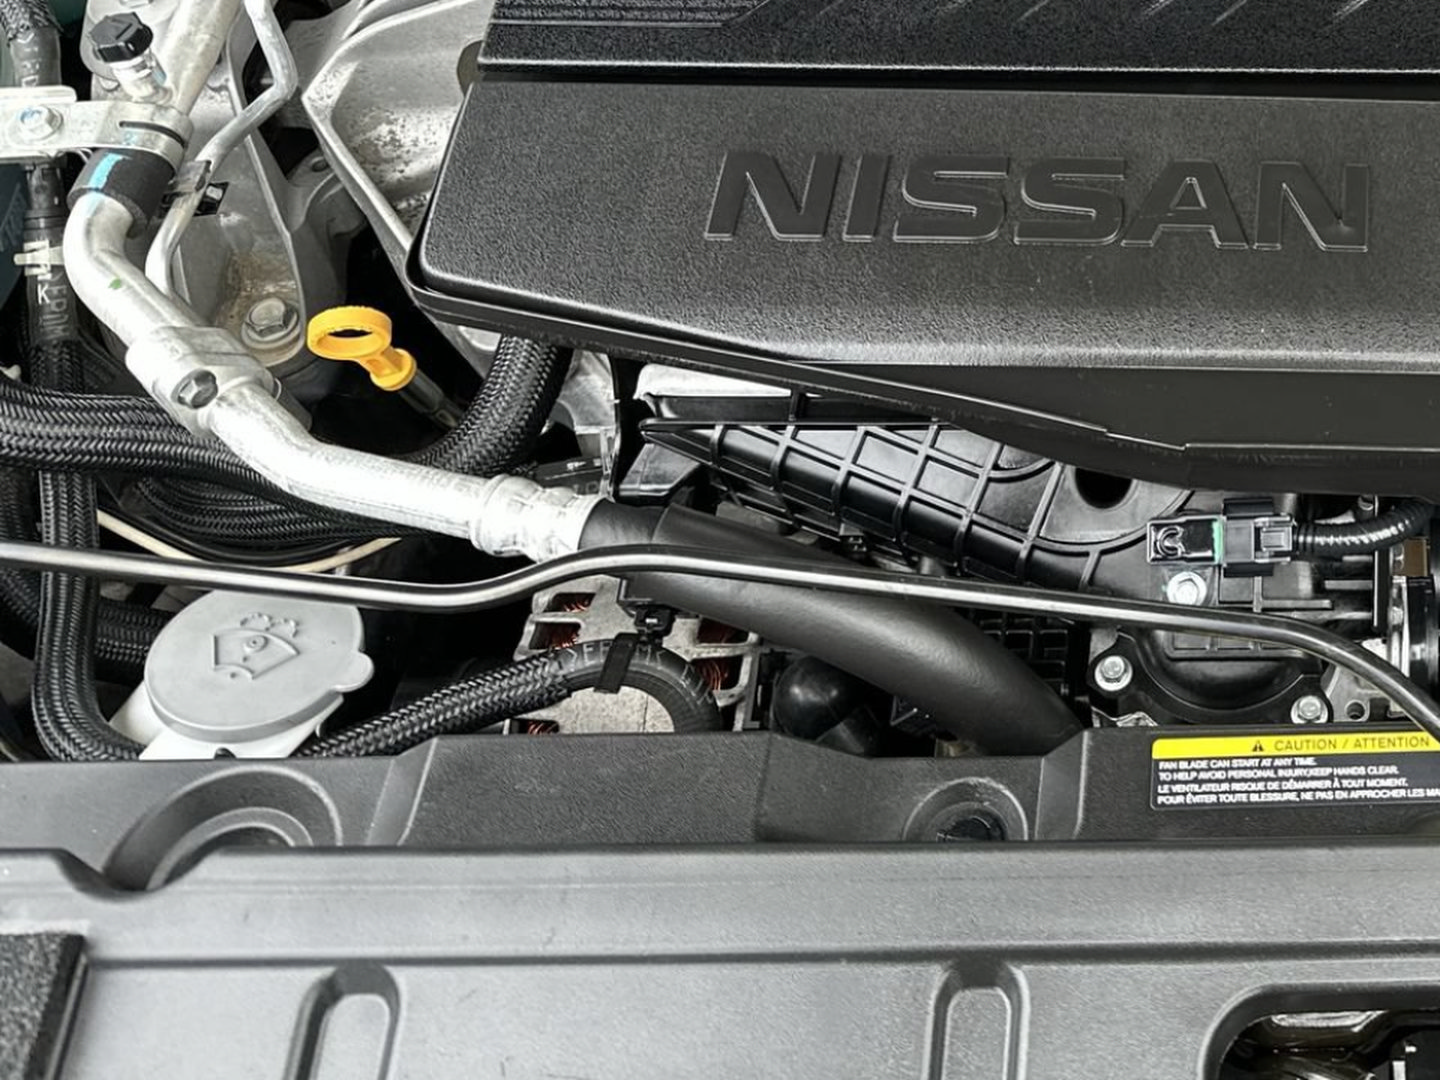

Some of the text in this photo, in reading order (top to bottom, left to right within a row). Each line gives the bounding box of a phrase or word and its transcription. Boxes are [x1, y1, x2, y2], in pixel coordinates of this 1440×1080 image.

[704, 150, 1368, 252] NISSAN
[1274, 738, 1336, 751] CAUTION
[1353, 735, 1429, 748] ATTENTION
[1158, 760, 1176, 769] FAN
[1178, 759, 1208, 769] BLADE
[1209, 759, 1229, 768] CAN
[1231, 758, 1259, 767] START
[1260, 757, 1271, 766] AT
[1273, 757, 1292, 766] ANY
[1158, 771, 1171, 780] TO
[1173, 770, 1197, 780] HELP
[1198, 770, 1225, 779] AVOID
[1227, 768, 1275, 778] PERSONAL
[1333, 766, 1365, 775] HANDS
[1367, 765, 1398, 774] CLEAR.
[1157, 784, 1169, 793] LE
[1171, 782, 1229, 793] VENTILATEUR
[1231, 781, 1265, 791] RISQUE
[1267, 781, 1279, 790] DE
[1281, 777, 1331, 790] DÉMARRER
[1341, 778, 1365, 788] TOUT
[1366, 777, 1408, 787] MOMENT.
[1157, 795, 1184, 804] POUR
[1218, 793, 1248, 802] TOUTE
[1249, 791, 1299, 802] BLESSURE,
[1300, 791, 1313, 800] NE
[1315, 790, 1333, 799] PAS
[1335, 790, 1348, 799] EN
[1349, 788, 1406, 798] APPROCHER
[1407, 788, 1424, 797] LES
